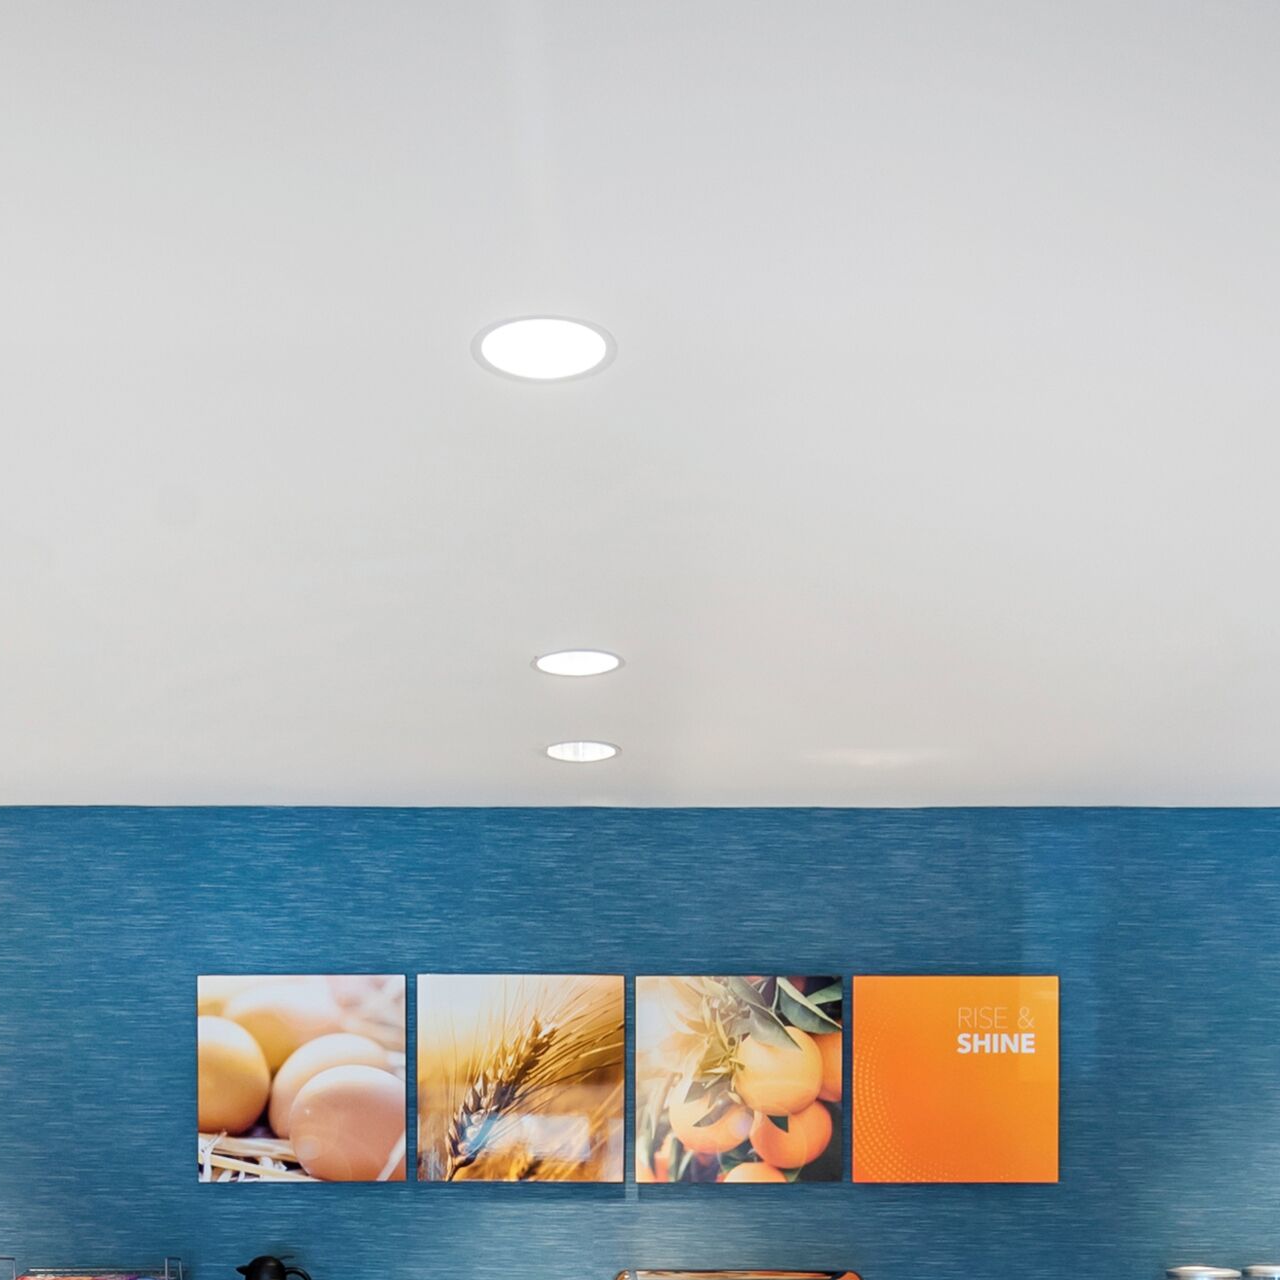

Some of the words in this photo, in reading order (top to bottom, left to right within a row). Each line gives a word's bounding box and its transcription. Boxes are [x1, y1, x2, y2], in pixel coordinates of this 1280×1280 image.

[957, 1006, 1008, 1029] RISE
[1017, 1006, 1035, 1029] &
[956, 1033, 1036, 1054] SHINE
